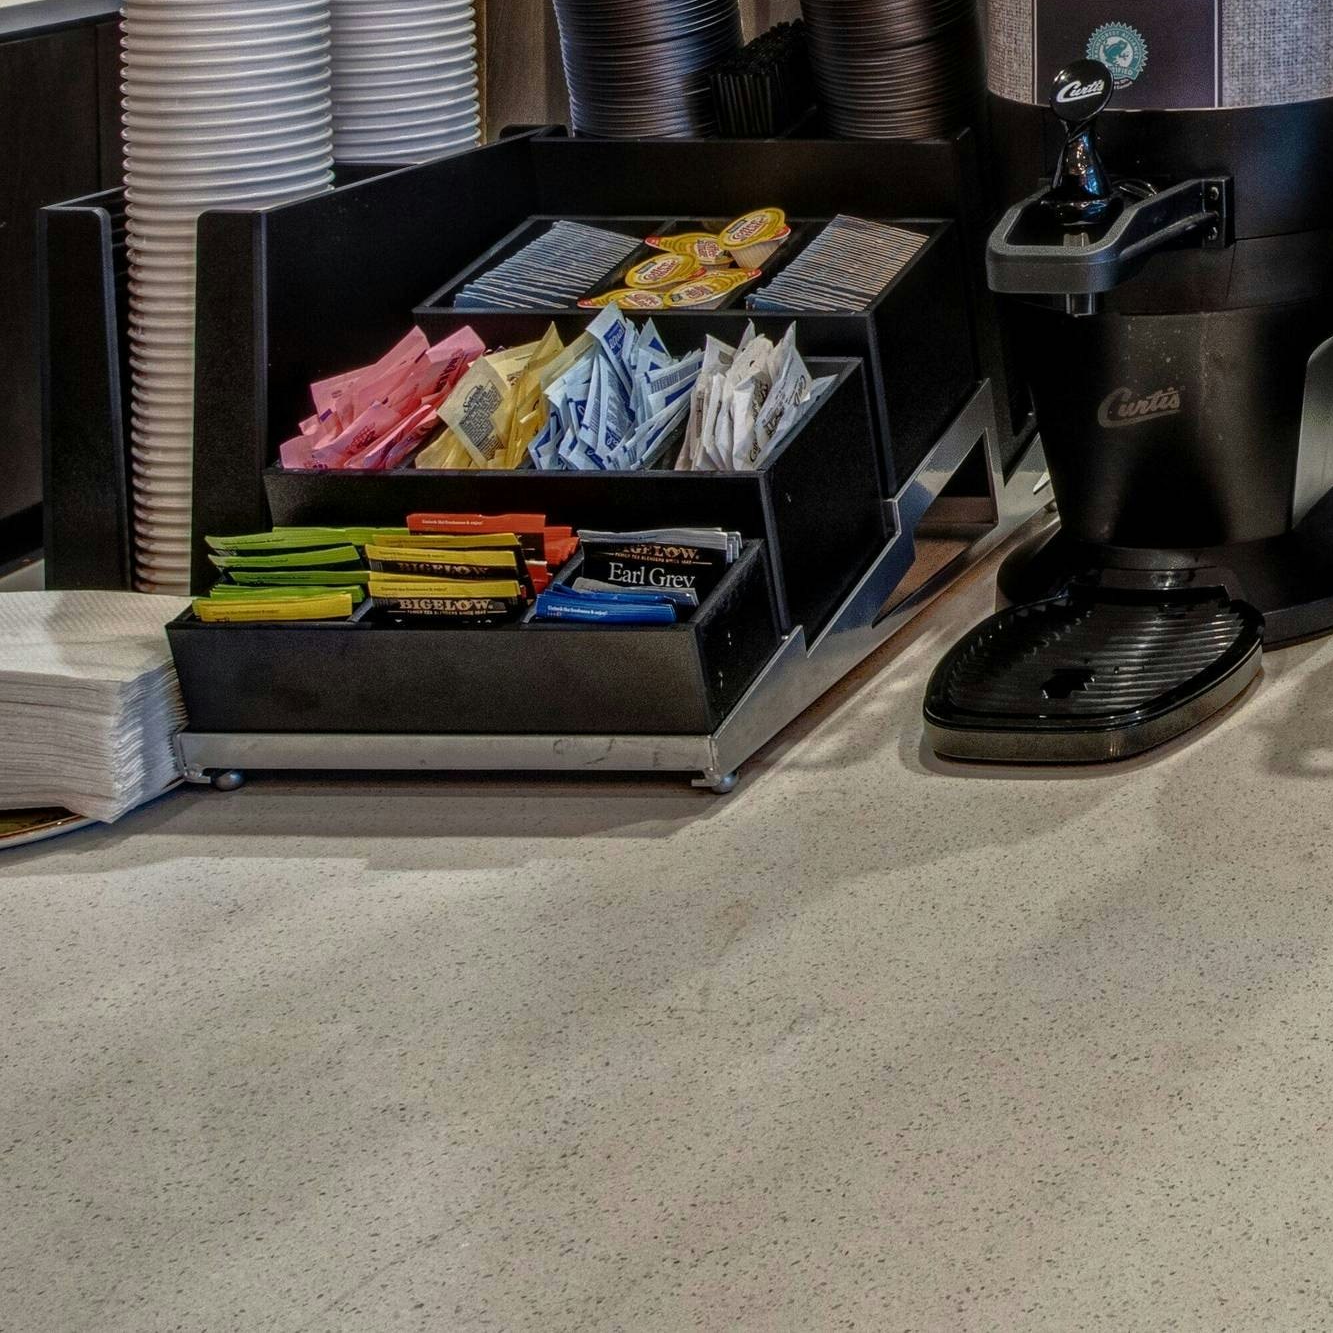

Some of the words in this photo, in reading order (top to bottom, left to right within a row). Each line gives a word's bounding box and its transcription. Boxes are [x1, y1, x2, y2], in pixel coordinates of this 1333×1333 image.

[1056, 79, 1105, 103] Curtis
[1097, 386, 1181, 429] Curtis
[608, 561, 645, 585] Earl
[397, 599, 490, 611] BIGELOW
